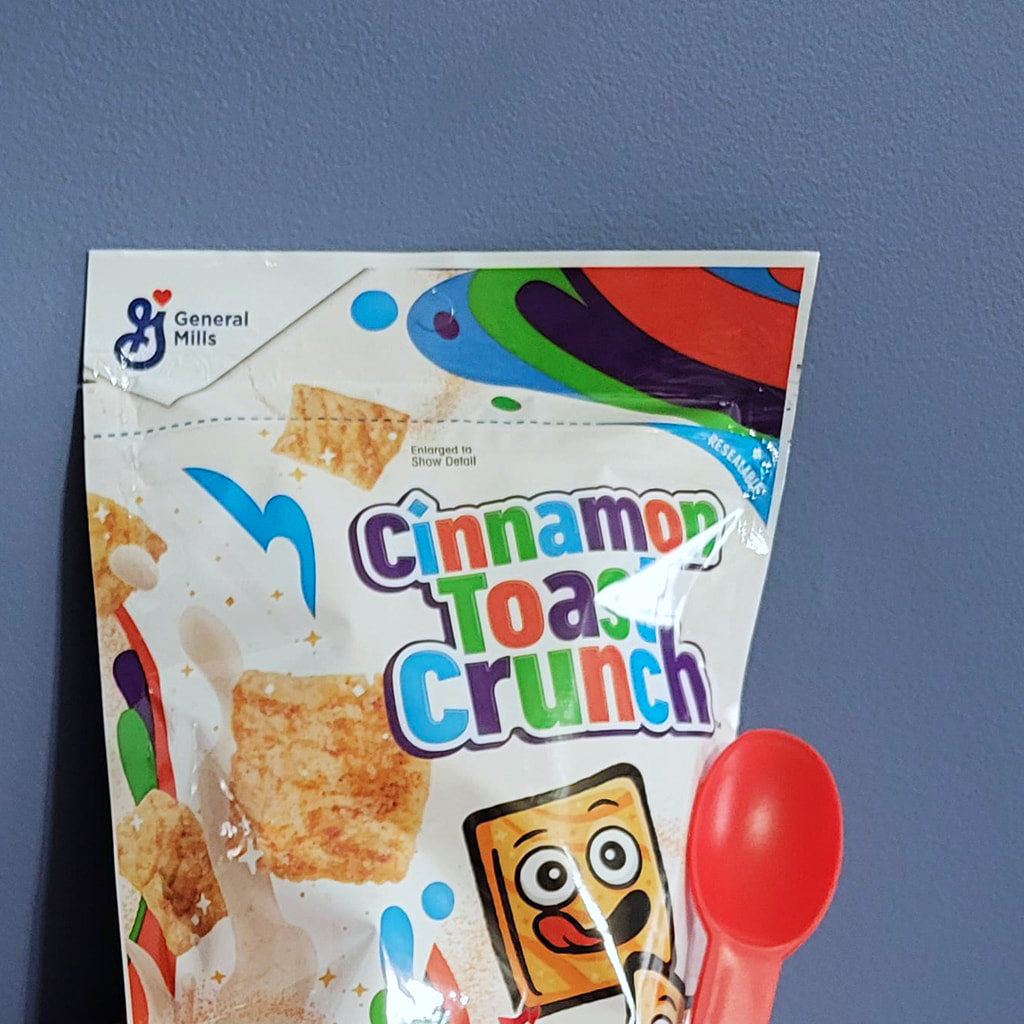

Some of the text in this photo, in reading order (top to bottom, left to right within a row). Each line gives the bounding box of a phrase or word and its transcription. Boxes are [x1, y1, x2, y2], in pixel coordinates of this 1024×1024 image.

[175, 310, 249, 327] General
[175, 331, 217, 346] Mills
[411, 445, 472, 456] Enlarged to
[411, 456, 476, 467] Show Detail
[707, 433, 768, 500] RESEALABLE
[364, 495, 720, 580] Cinnamon
[397, 626, 713, 747] Crunch
